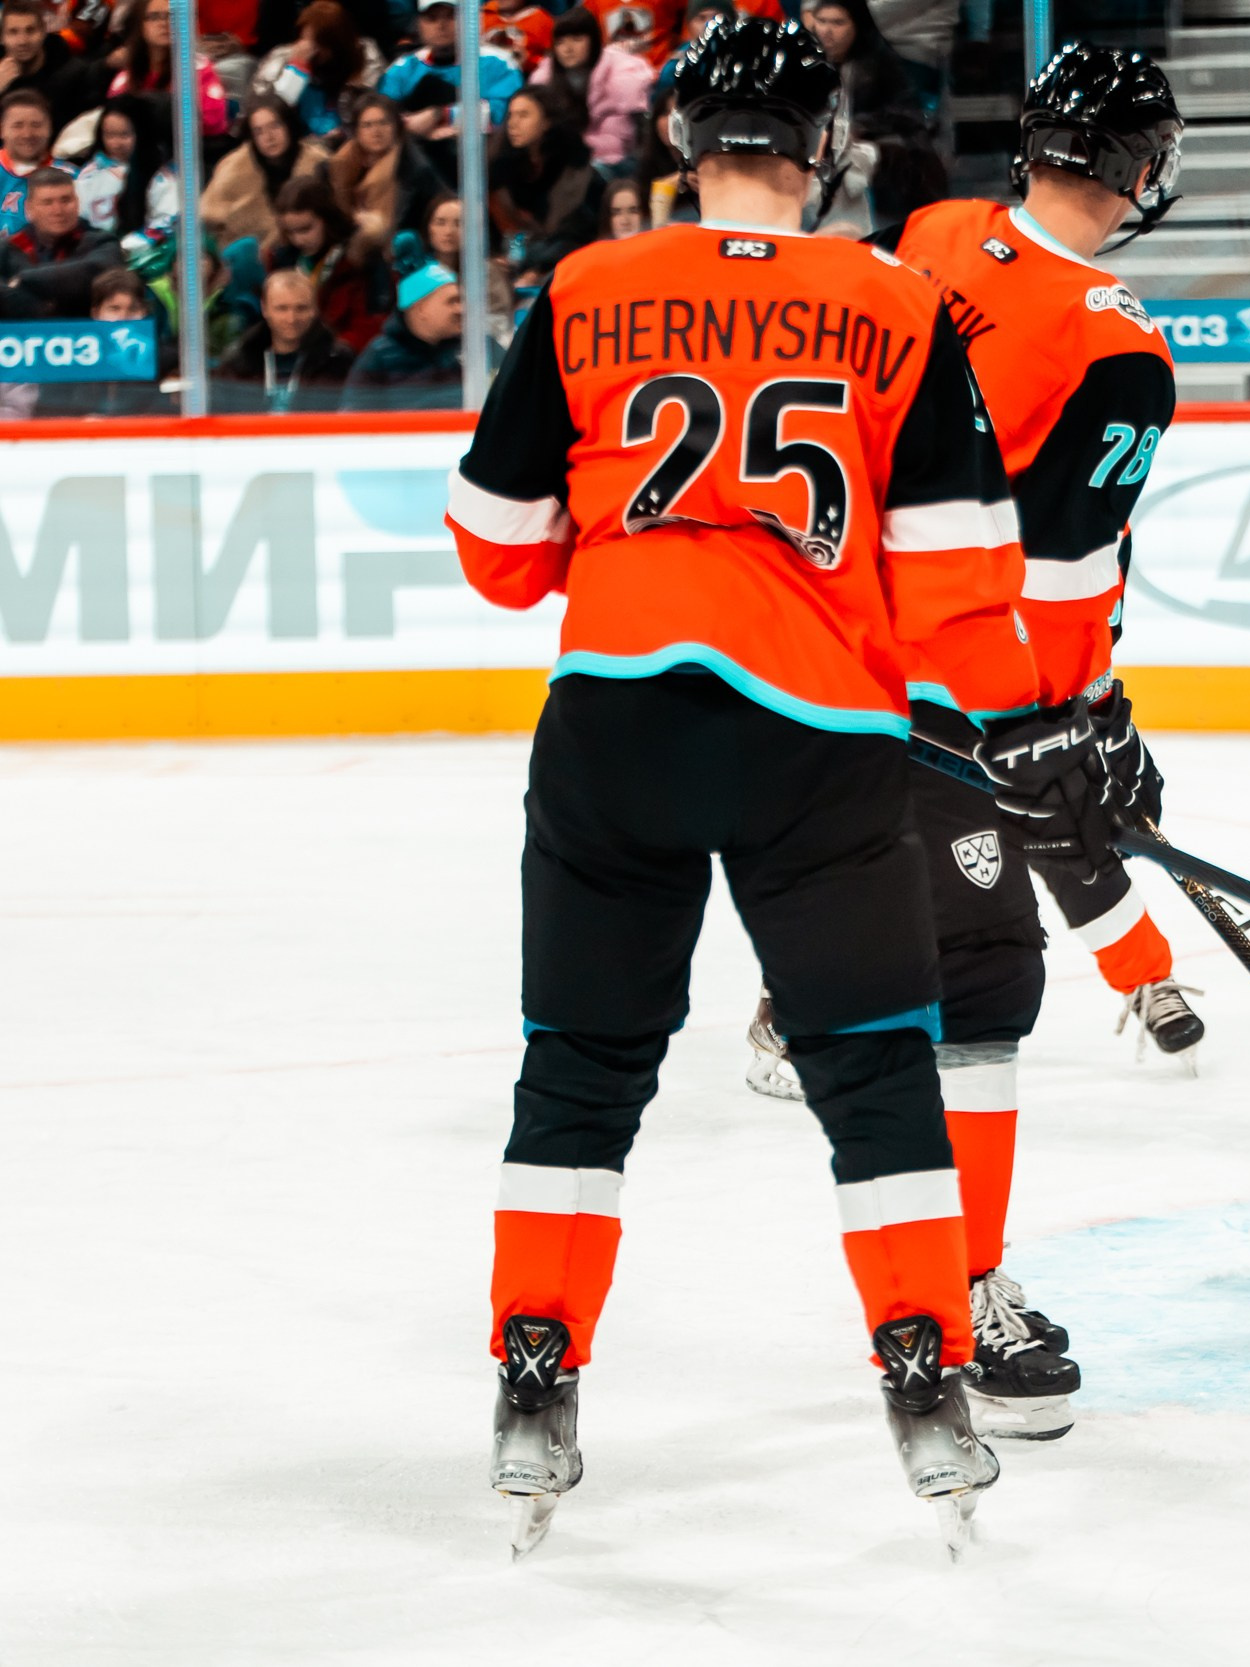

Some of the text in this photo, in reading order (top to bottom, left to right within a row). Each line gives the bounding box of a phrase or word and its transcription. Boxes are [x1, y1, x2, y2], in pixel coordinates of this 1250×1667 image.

[0, 336, 100, 368] огаз
[562, 299, 915, 394] CHERNYSHOV
[621, 373, 849, 570] 25
[1089, 423, 1162, 489] 78
[991, 722, 1095, 769] TRU
